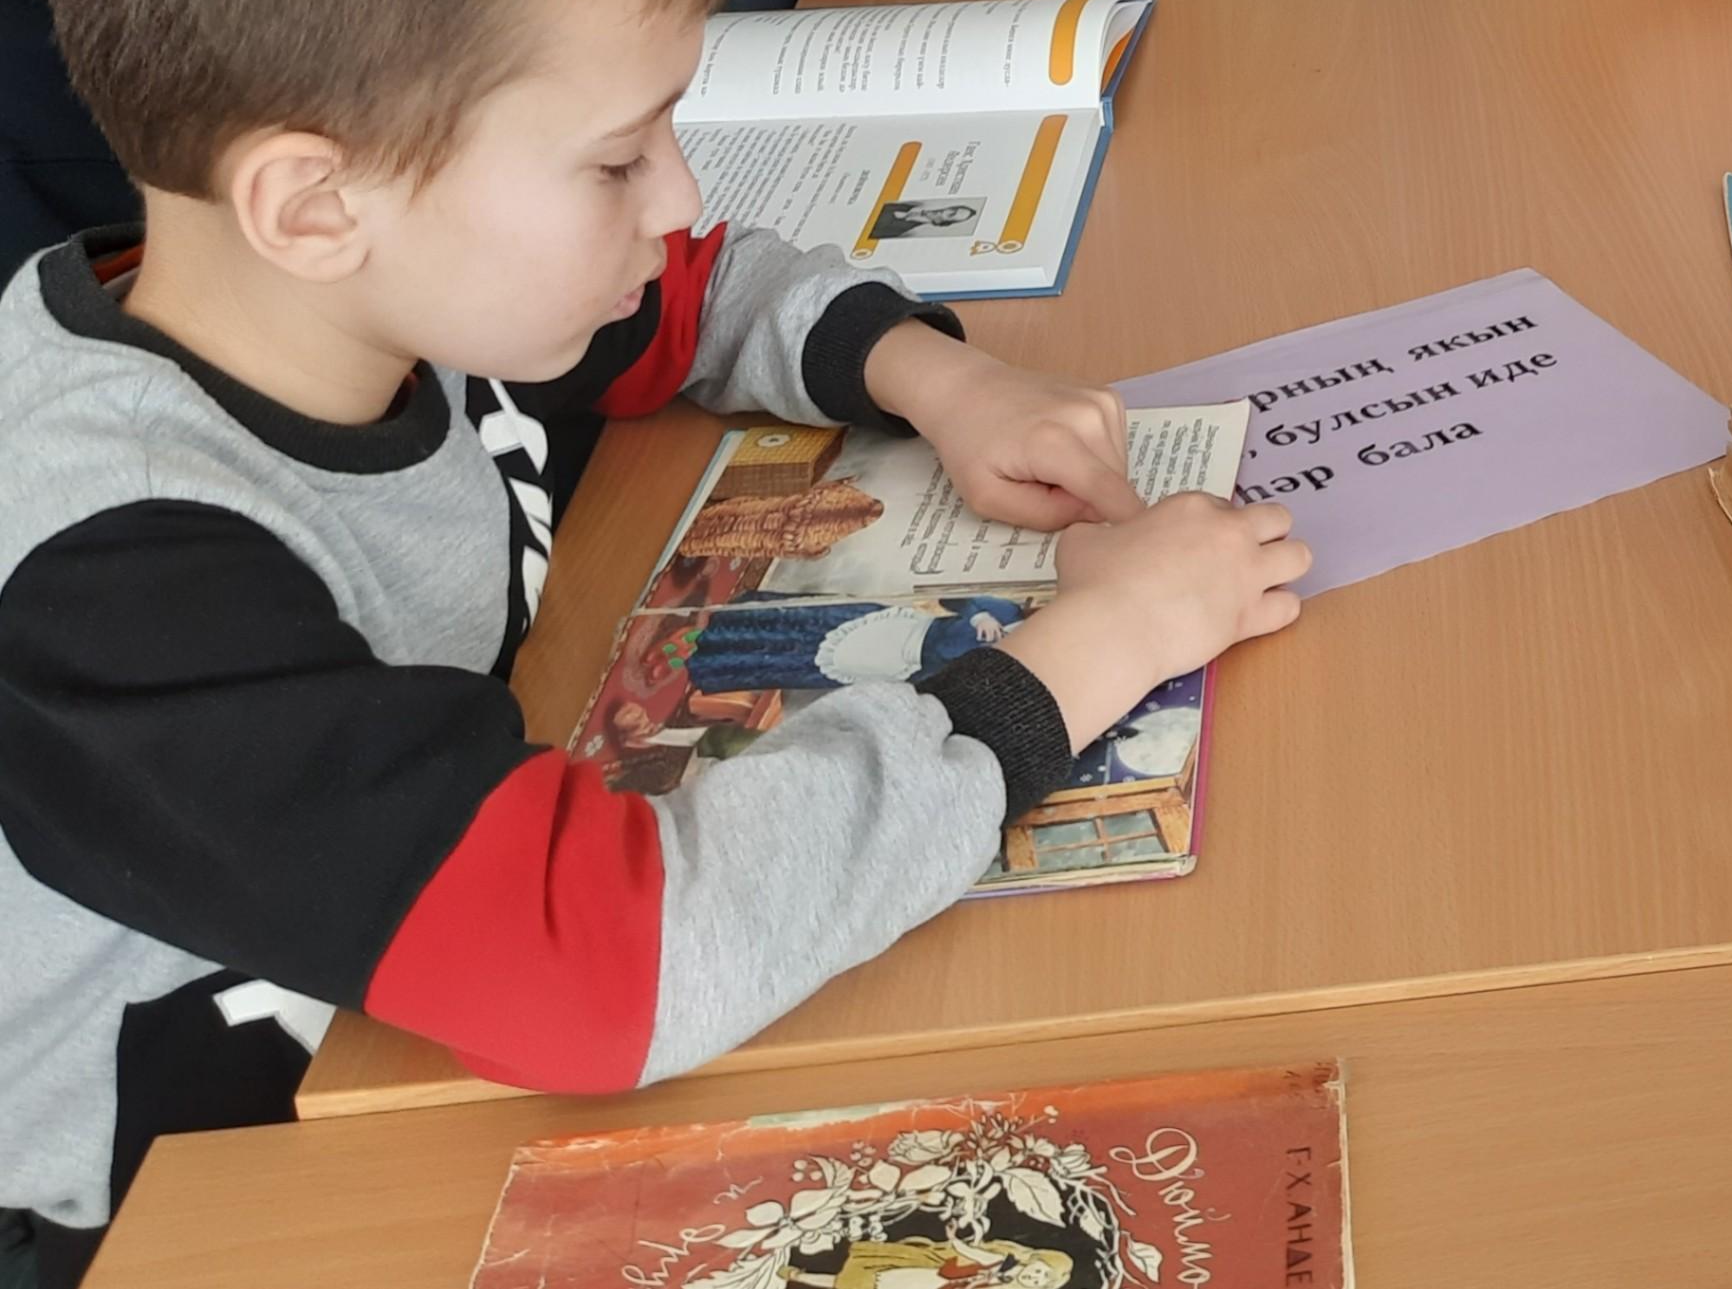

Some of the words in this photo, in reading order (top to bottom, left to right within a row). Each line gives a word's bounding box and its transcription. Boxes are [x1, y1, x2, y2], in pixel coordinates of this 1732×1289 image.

[1248, 357, 1393, 414] рның
[1406, 312, 1539, 363] якын
[1264, 379, 1459, 449] булсын
[1464, 348, 1559, 389] иде
[1356, 419, 1483, 469] бала
[1109, 1126, 1232, 1289] Дюймо
